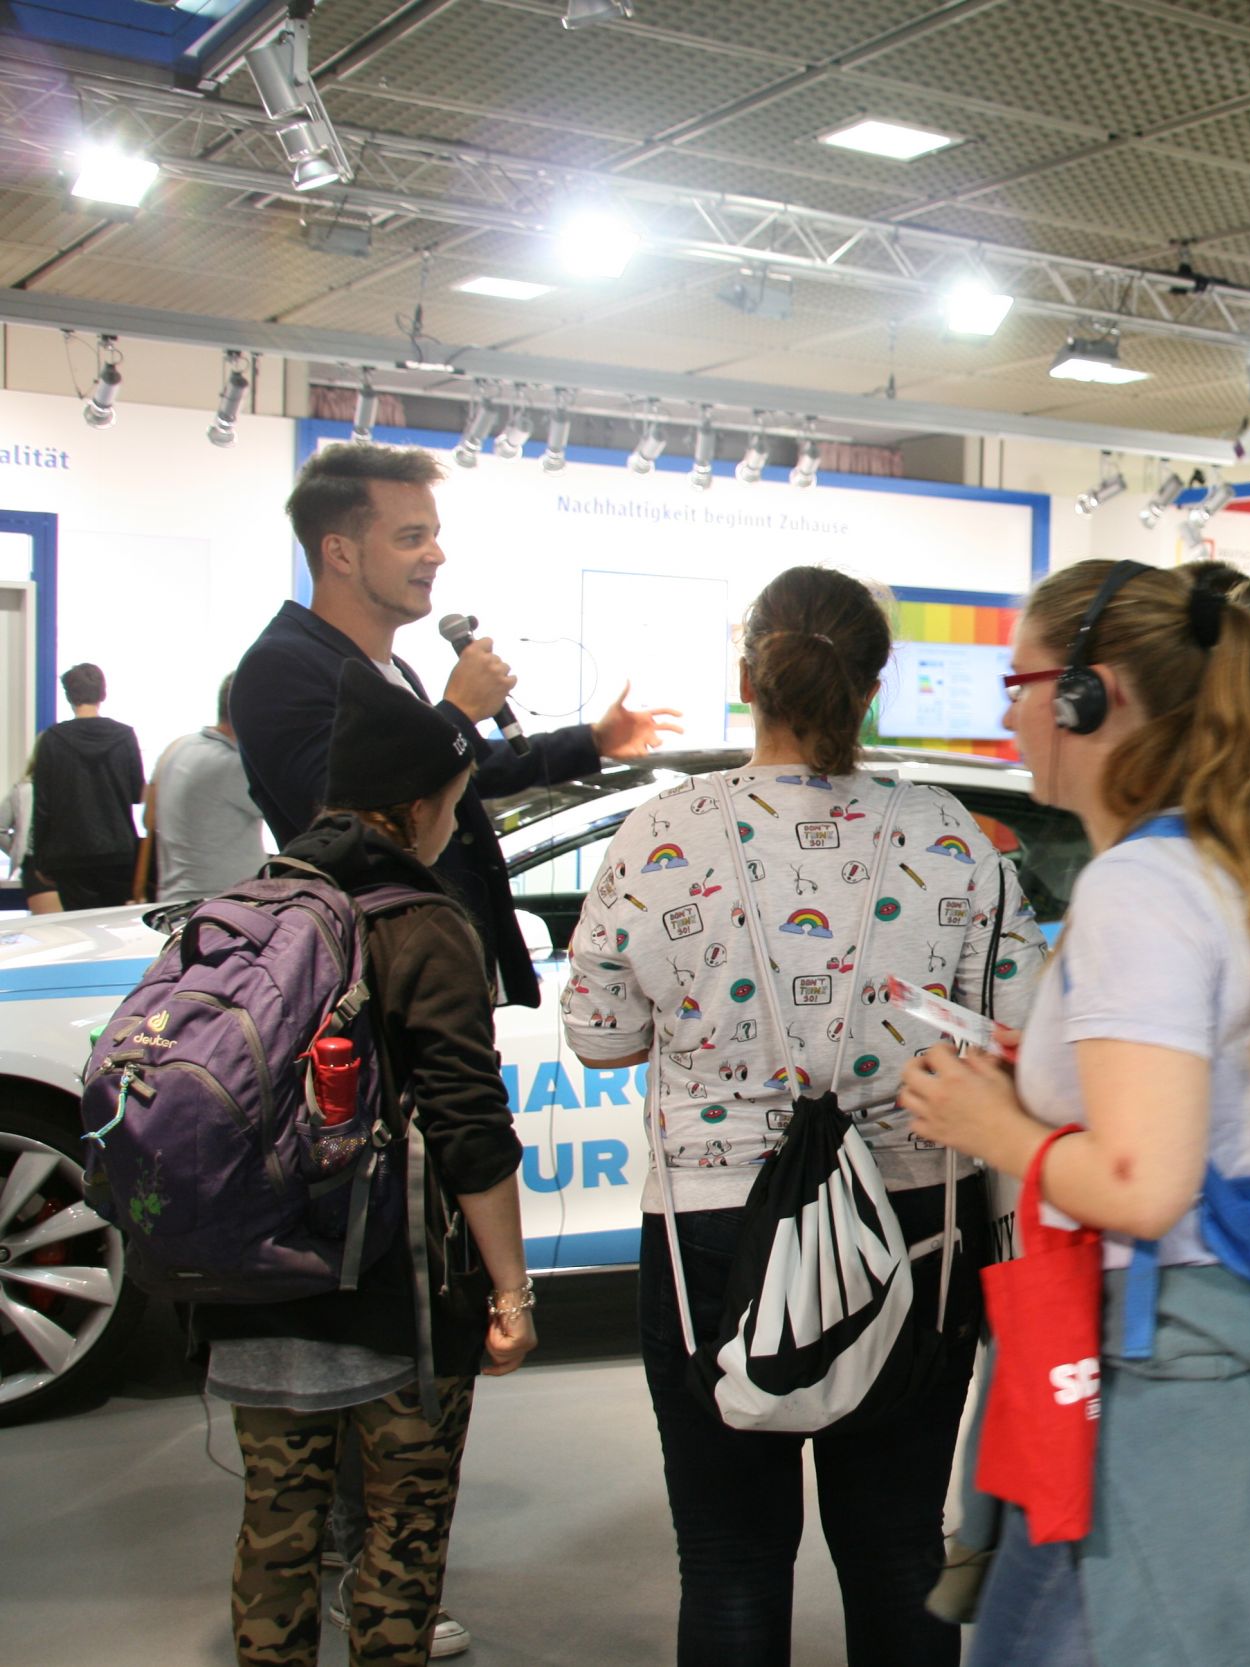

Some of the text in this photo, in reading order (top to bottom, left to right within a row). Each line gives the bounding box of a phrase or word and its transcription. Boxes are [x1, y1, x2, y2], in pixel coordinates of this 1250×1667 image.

[556, 495, 849, 535] Nachhaltigkeit beginnt Zuhause
[133, 1032, 178, 1049] deuter
[500, 1059, 650, 1115] AR
